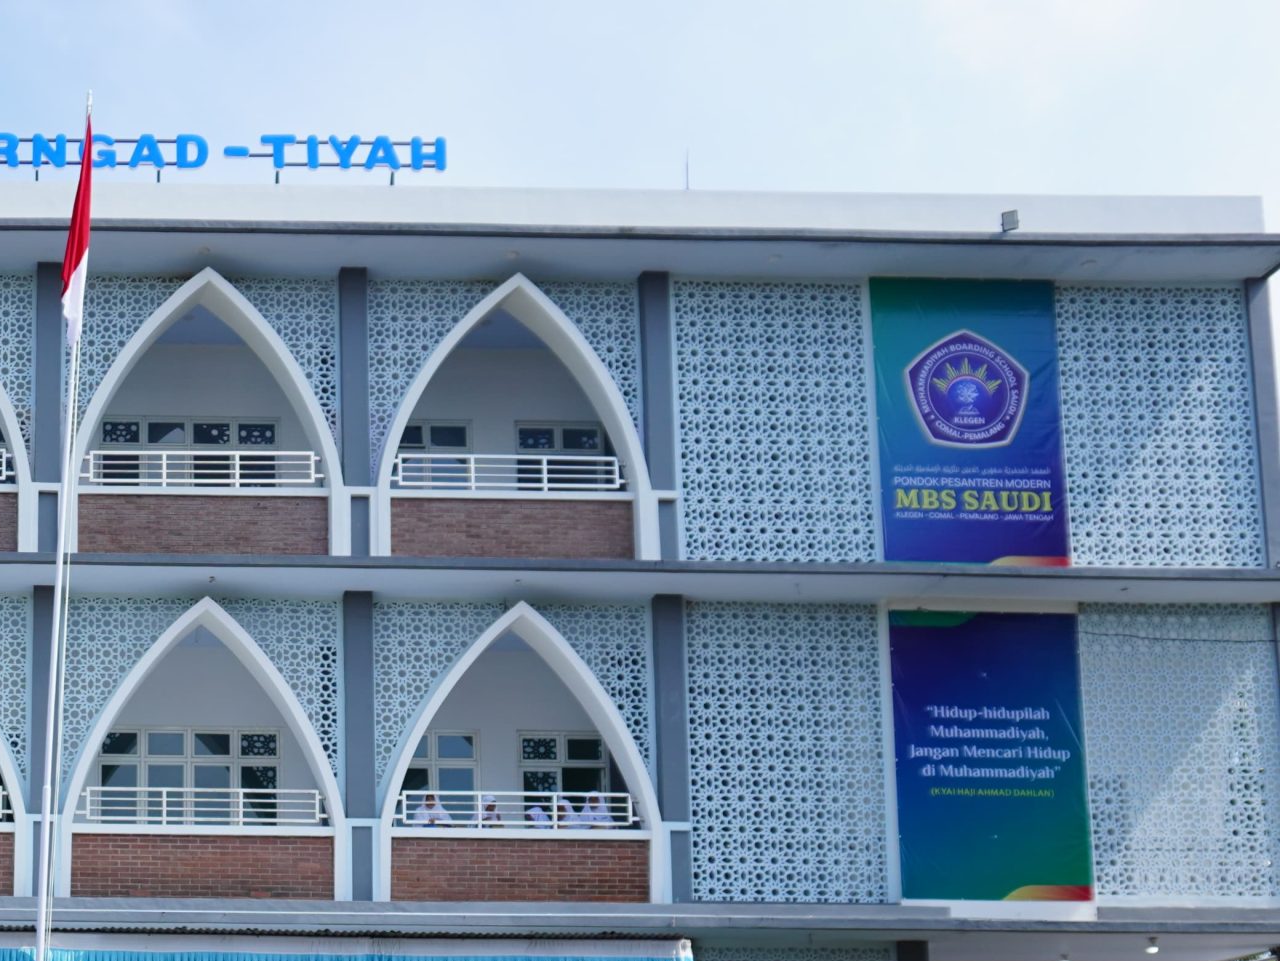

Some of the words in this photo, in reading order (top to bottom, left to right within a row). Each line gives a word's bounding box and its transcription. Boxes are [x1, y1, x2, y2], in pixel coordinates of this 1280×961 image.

[918, 347, 949, 414] MUHAMMADIYAH
[949, 343, 995, 358] BOARDING
[995, 354, 1017, 387] SCHOOL
[1008, 389, 1019, 415] SAUDI
[954, 416, 985, 424] KLEGEN
[894, 476, 941, 486] PONDOK
[942, 477, 1003, 487] PESANTREN
[1005, 479, 1051, 488] MODERN
[896, 488, 957, 510] MBS
[963, 490, 1053, 512] SAUDI
[930, 725, 1049, 742] Muhammadiyah,
[909, 744, 960, 760] Jangan
[963, 745, 1023, 759] Mencari
[1027, 746, 1071, 762] Hidup
[922, 765, 936, 777] di
[976, 788, 1011, 798] AHMAD
